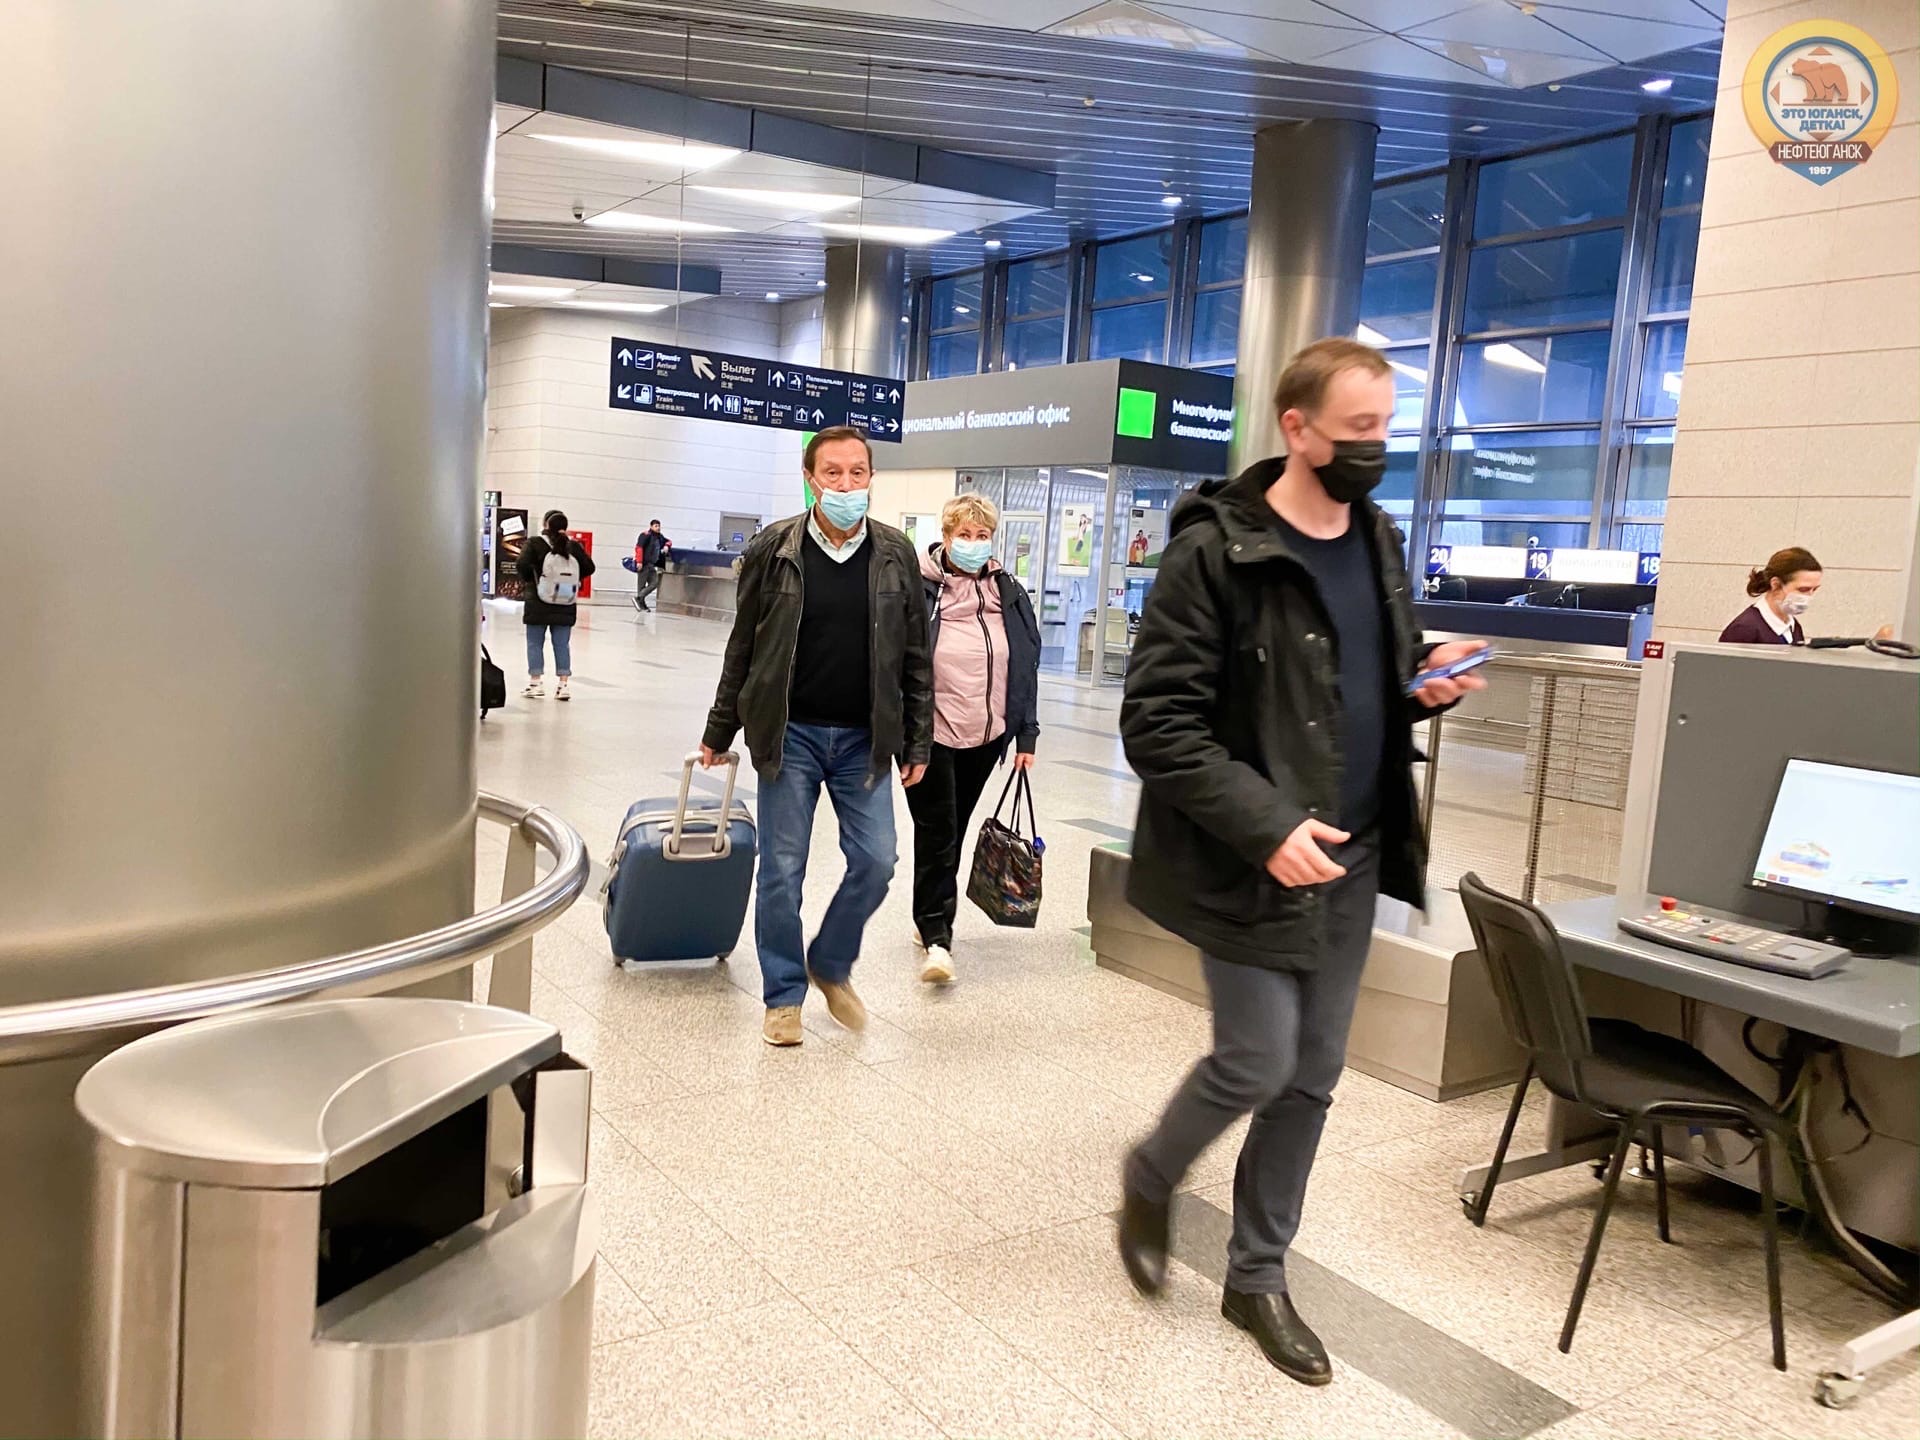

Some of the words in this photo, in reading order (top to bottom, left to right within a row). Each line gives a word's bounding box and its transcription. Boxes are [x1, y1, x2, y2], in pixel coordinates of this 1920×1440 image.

[721, 361, 757, 376] Вылет
[721, 373, 754, 383] Departure
[656, 395, 673, 403] Train
[743, 397, 765, 407] Туалет
[743, 406, 755, 414] WC
[771, 401, 792, 411] Выход
[771, 409, 784, 418] Exit
[850, 412, 868, 420] Кассы
[966, 405, 1035, 429] банковский
[1036, 403, 1071, 428] офис
[1430, 548, 1448, 564] 20
[1529, 552, 1548, 569] 19
[1641, 556, 1659, 574] 18
